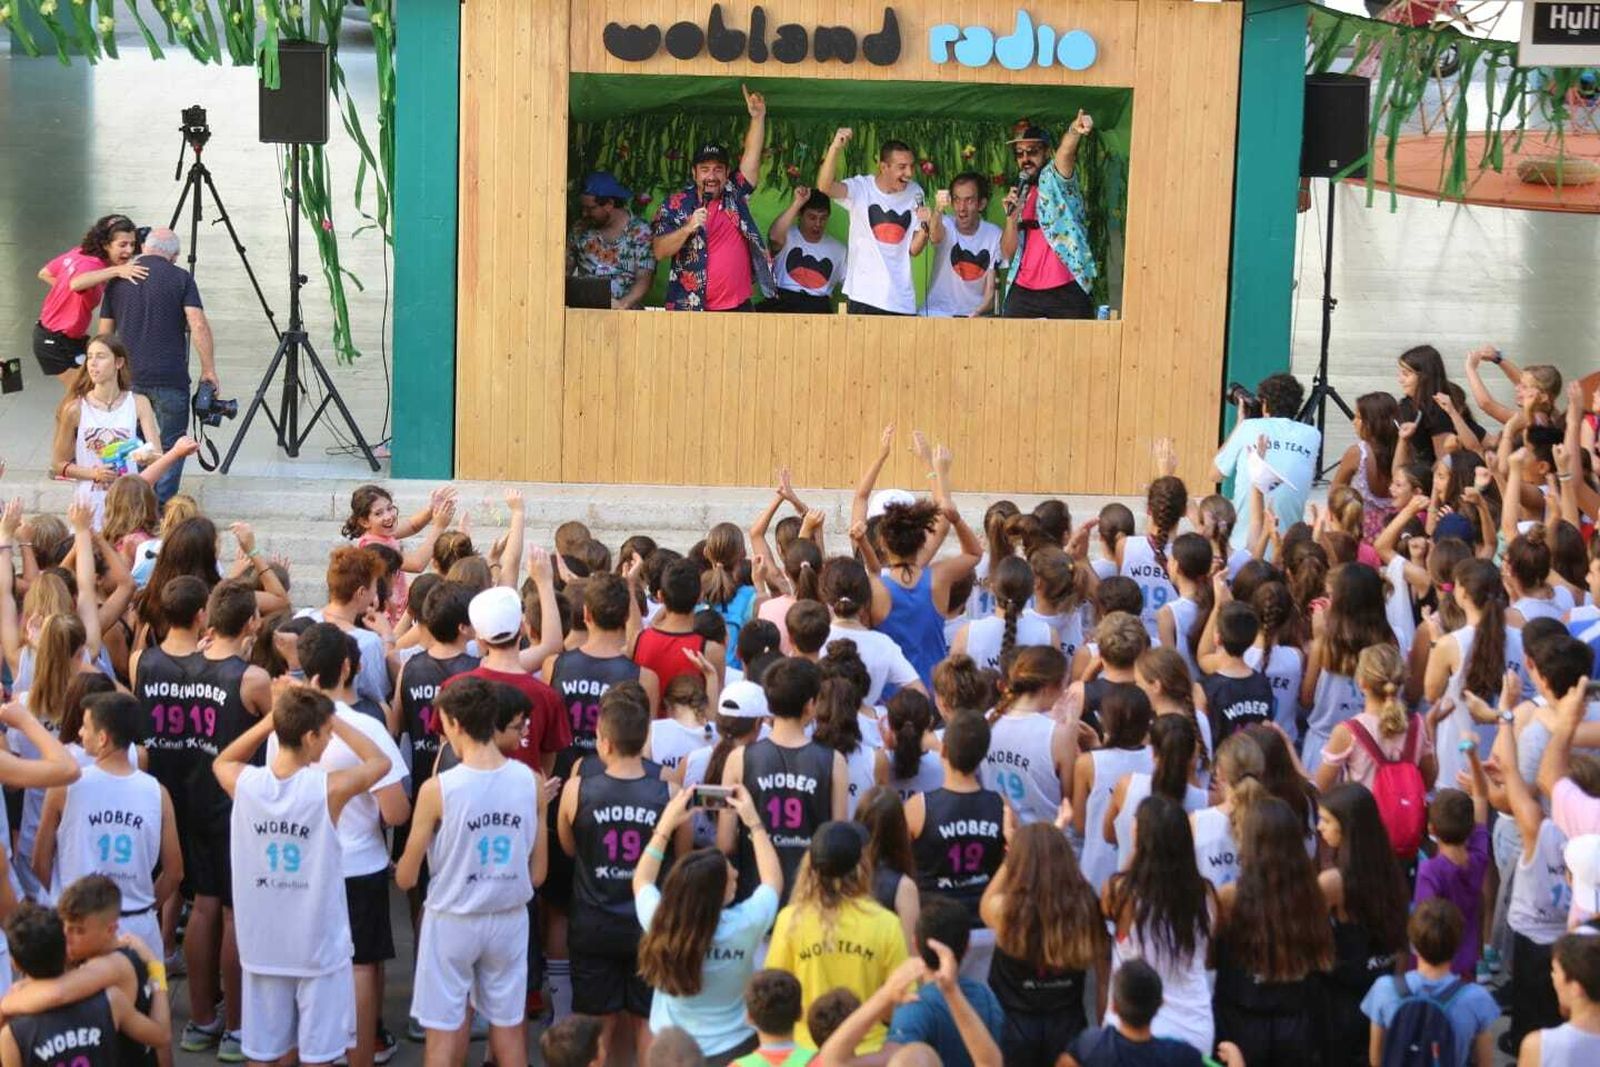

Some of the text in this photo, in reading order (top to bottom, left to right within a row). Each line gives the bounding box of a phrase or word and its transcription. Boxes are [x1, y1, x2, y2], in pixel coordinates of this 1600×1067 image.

[603, 3, 1097, 71] wobland radio
[1285, 441, 1312, 458] TEAM
[184, 683, 227, 706] WOBER
[151, 703, 185, 734] 19
[190, 704, 216, 737] 19
[1223, 700, 1269, 720] WOBER
[757, 772, 817, 794] WOBER
[88, 810, 143, 829] WOBER
[467, 812, 522, 831] WOBER
[593, 805, 657, 826] WOBER
[767, 796, 803, 829] 19
[254, 820, 310, 839] WOBER
[938, 819, 999, 838] WOBER
[97, 833, 132, 864] 19
[477, 834, 512, 866] 19
[602, 827, 641, 863] 19
[265, 842, 301, 872] 19
[947, 841, 985, 873] 19
[705, 948, 745, 961] TEAM
[838, 940, 875, 961] TEAM
[34, 1027, 102, 1062] WOBER
